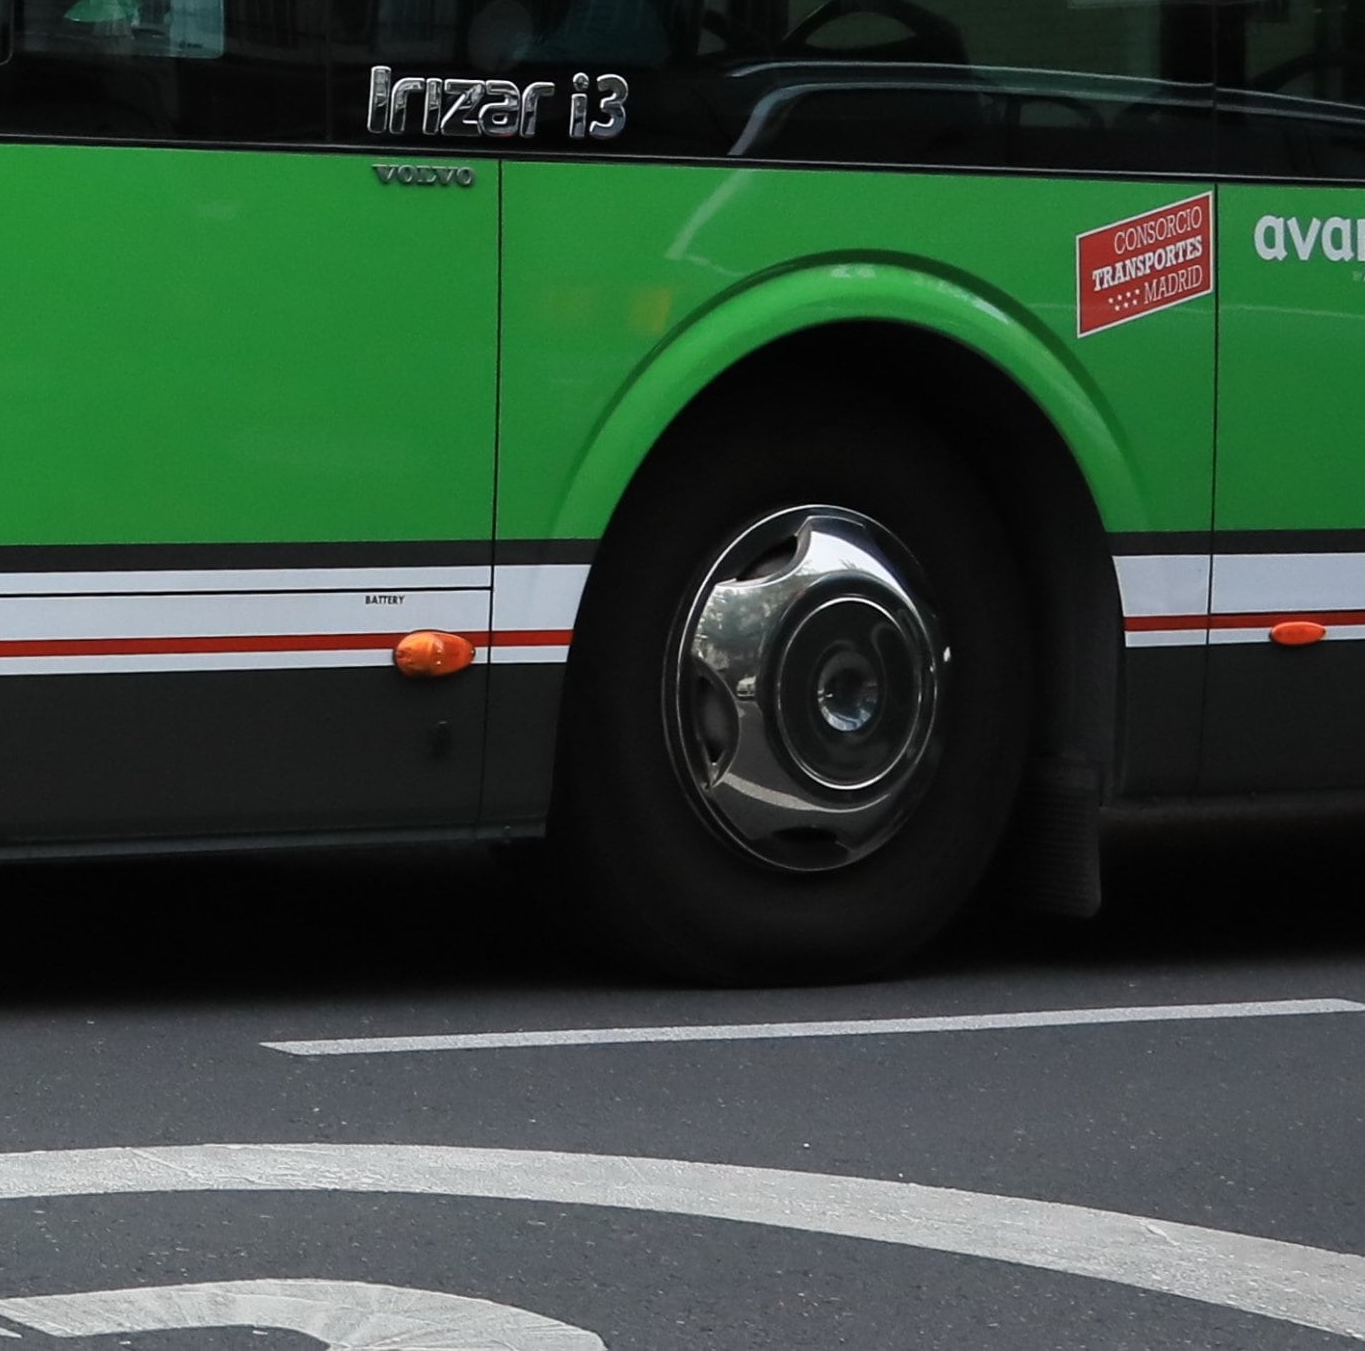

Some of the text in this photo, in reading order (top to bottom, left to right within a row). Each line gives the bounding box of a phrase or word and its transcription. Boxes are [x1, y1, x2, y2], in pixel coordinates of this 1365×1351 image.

[570, 72, 629, 138] i3
[372, 163, 475, 186] VOLVO
[1114, 206, 1203, 254] CONSORCIO
[1092, 235, 1203, 292] TRANSPORTES
[1143, 264, 1204, 305] MADRID
[365, 595, 406, 605] BATTERY
